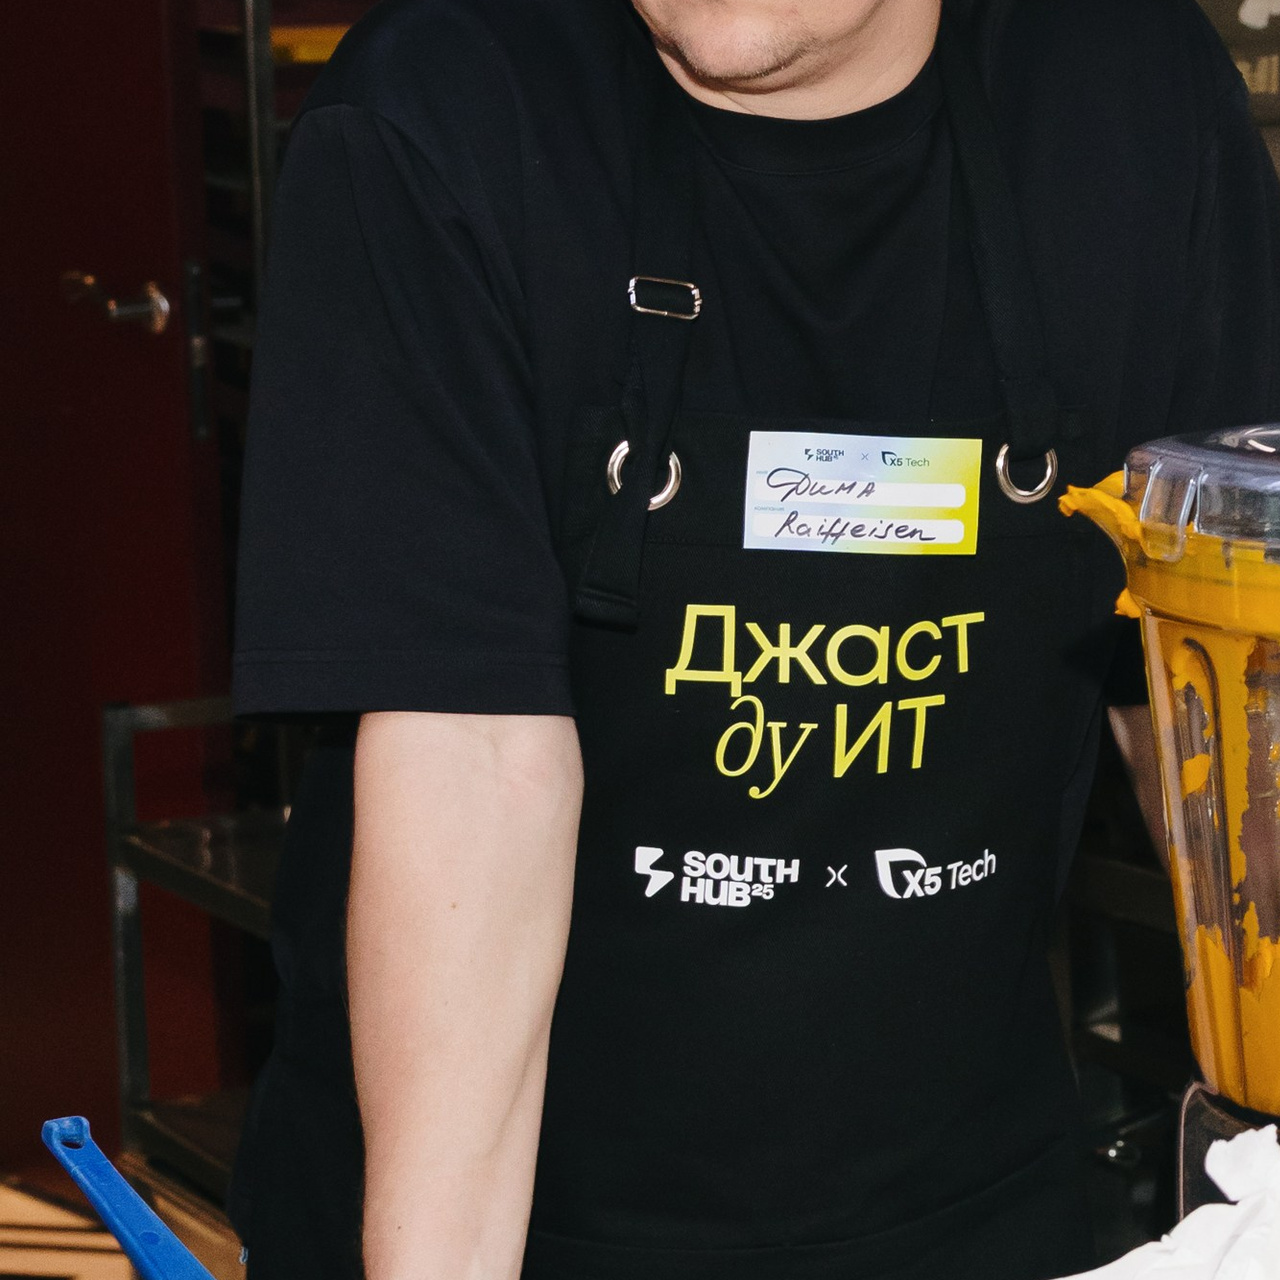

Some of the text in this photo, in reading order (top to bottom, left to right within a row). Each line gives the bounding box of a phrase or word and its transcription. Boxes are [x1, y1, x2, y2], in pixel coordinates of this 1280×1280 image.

[905, 457, 930, 467] Tech
[665, 603, 985, 698] Джаст
[714, 694, 946, 800] ду ИТ
[682, 849, 800, 884] SOUTH
[947, 848, 997, 892] Tech
